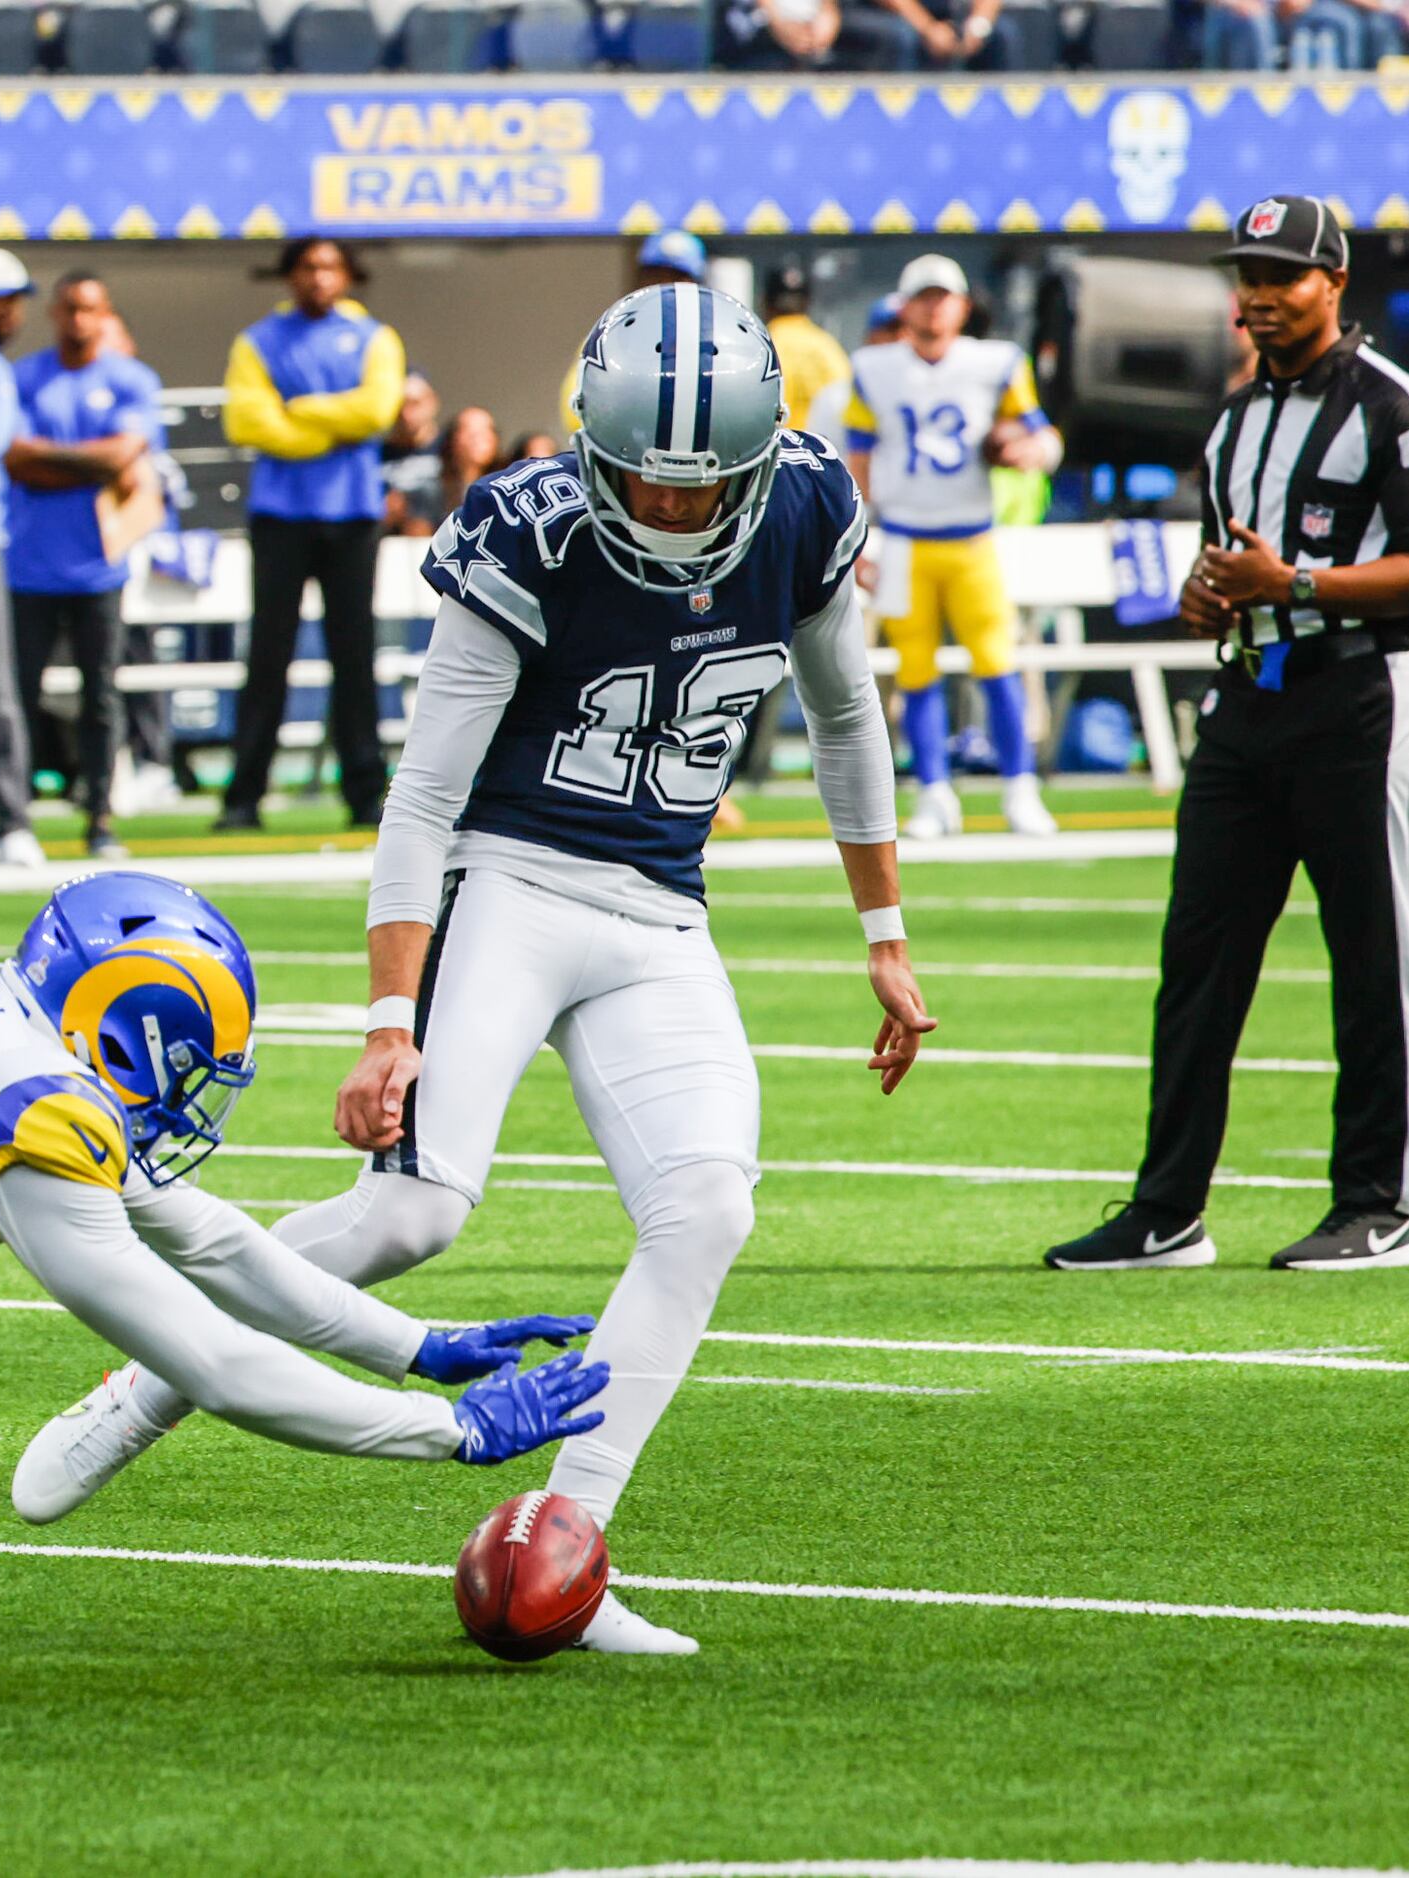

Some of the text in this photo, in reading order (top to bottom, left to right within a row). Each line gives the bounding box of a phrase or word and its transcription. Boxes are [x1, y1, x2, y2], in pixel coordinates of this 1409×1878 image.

[325, 99, 594, 153] VAMOS
[349, 167, 567, 209] RAMS
[898, 403, 969, 476] 13
[489, 460, 589, 527] 19
[543, 642, 789, 813] 19
